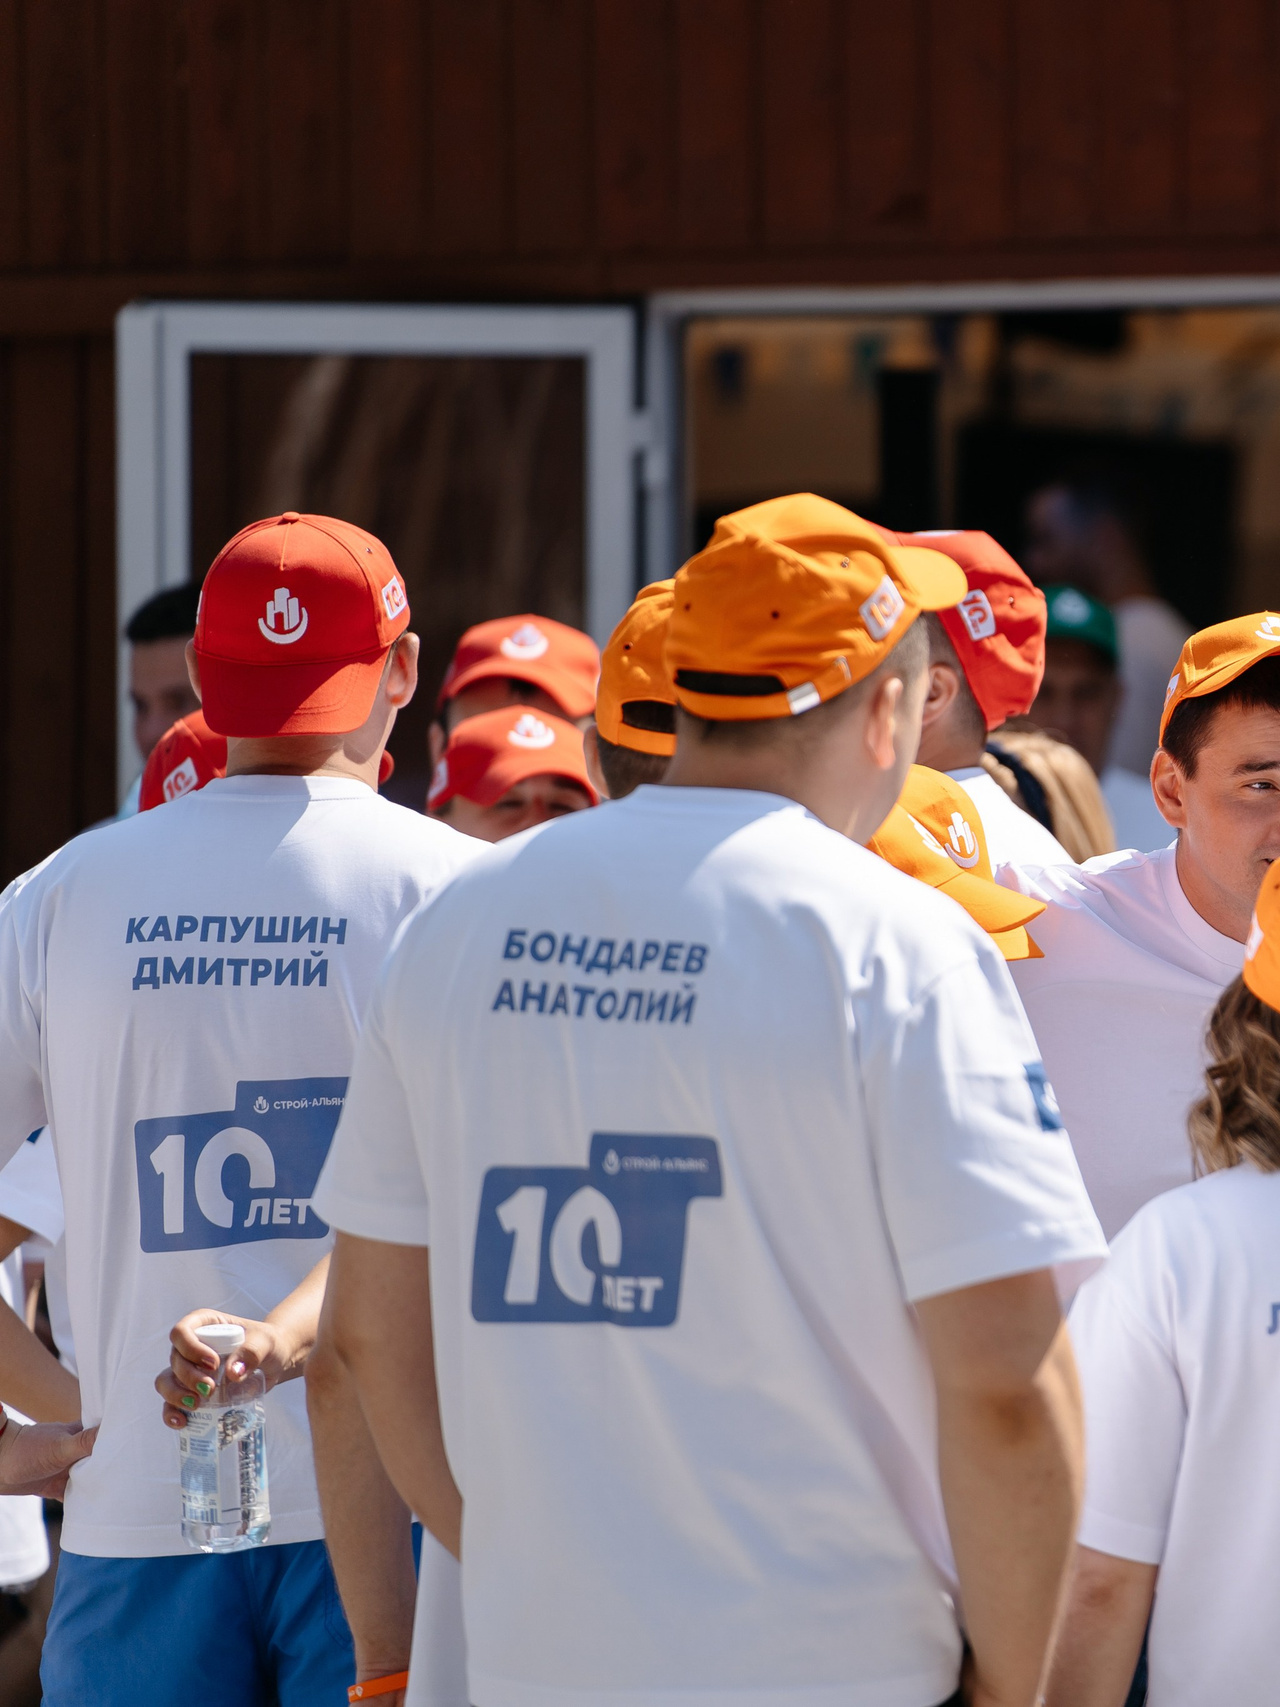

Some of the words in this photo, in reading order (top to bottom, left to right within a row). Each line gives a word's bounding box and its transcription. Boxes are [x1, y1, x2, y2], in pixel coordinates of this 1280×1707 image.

[125, 915, 348, 945] КАРПУШИН
[502, 928, 709, 975] БОНДАРЕВ
[132, 950, 329, 990] ДМИТРИЙ
[491, 978, 698, 1024] АНАТОЛИЙ
[273, 1097, 346, 1110] СТРОЙ-АЛЬЯН
[149, 1126, 276, 1235] 10
[243, 1198, 312, 1228] ЛЕТ
[495, 1184, 623, 1306] 10
